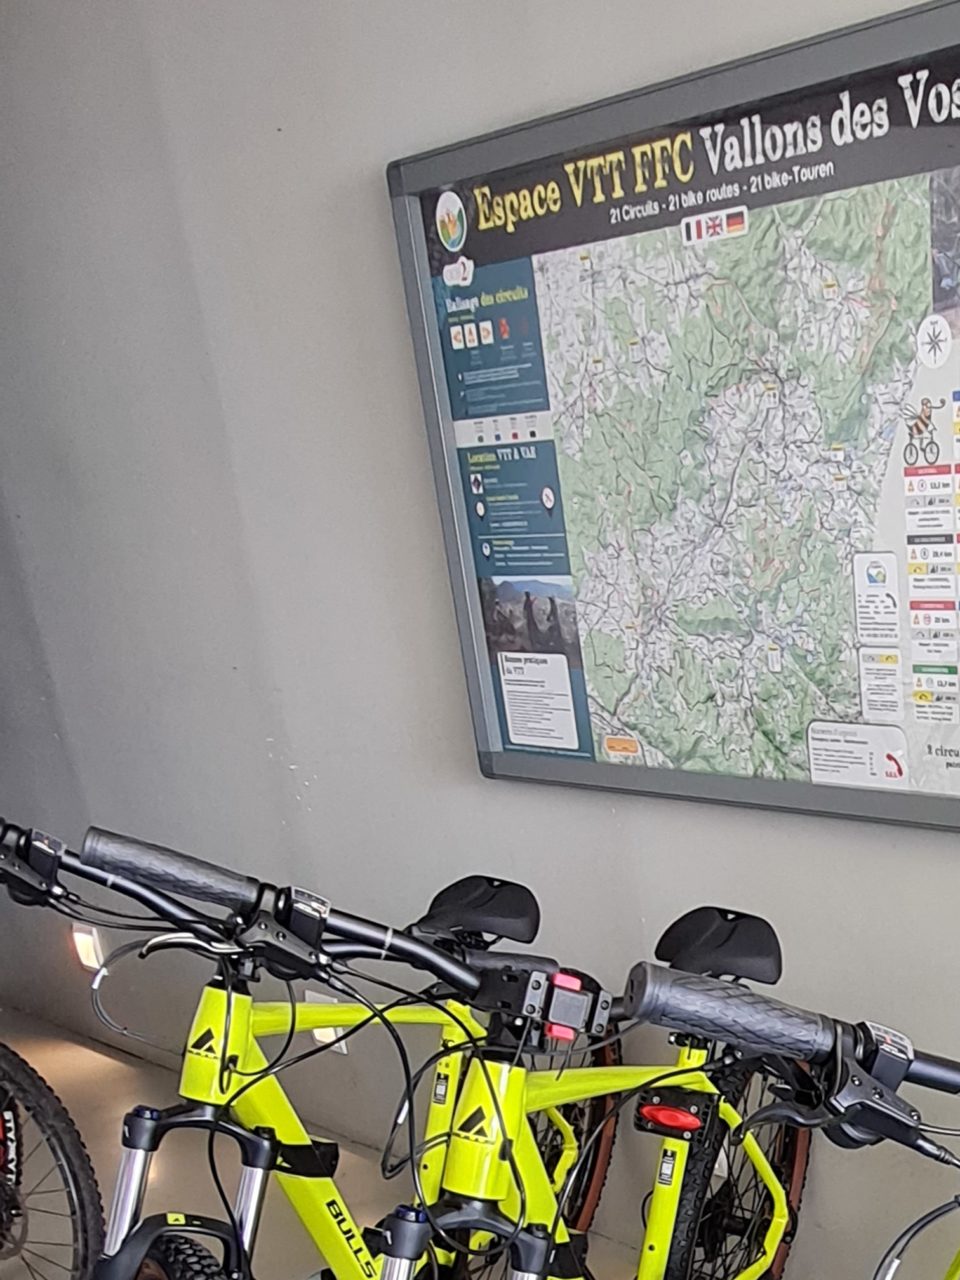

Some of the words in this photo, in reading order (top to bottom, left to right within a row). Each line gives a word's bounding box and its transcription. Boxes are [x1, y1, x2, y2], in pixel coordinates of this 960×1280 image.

[474, 181, 562, 233] Espace
[564, 151, 626, 208] VTT
[631, 131, 694, 194] FFC
[699, 114, 823, 176] Vallons
[830, 90, 891, 147] des
[610, 208, 622, 224] 21
[623, 200, 660, 222] Circuits
[668, 195, 680, 211] 21
[681, 189, 703, 206] bike
[706, 181, 740, 203] routes
[750, 175, 762, 194] 21
[326, 1199, 377, 1279] BULLS
